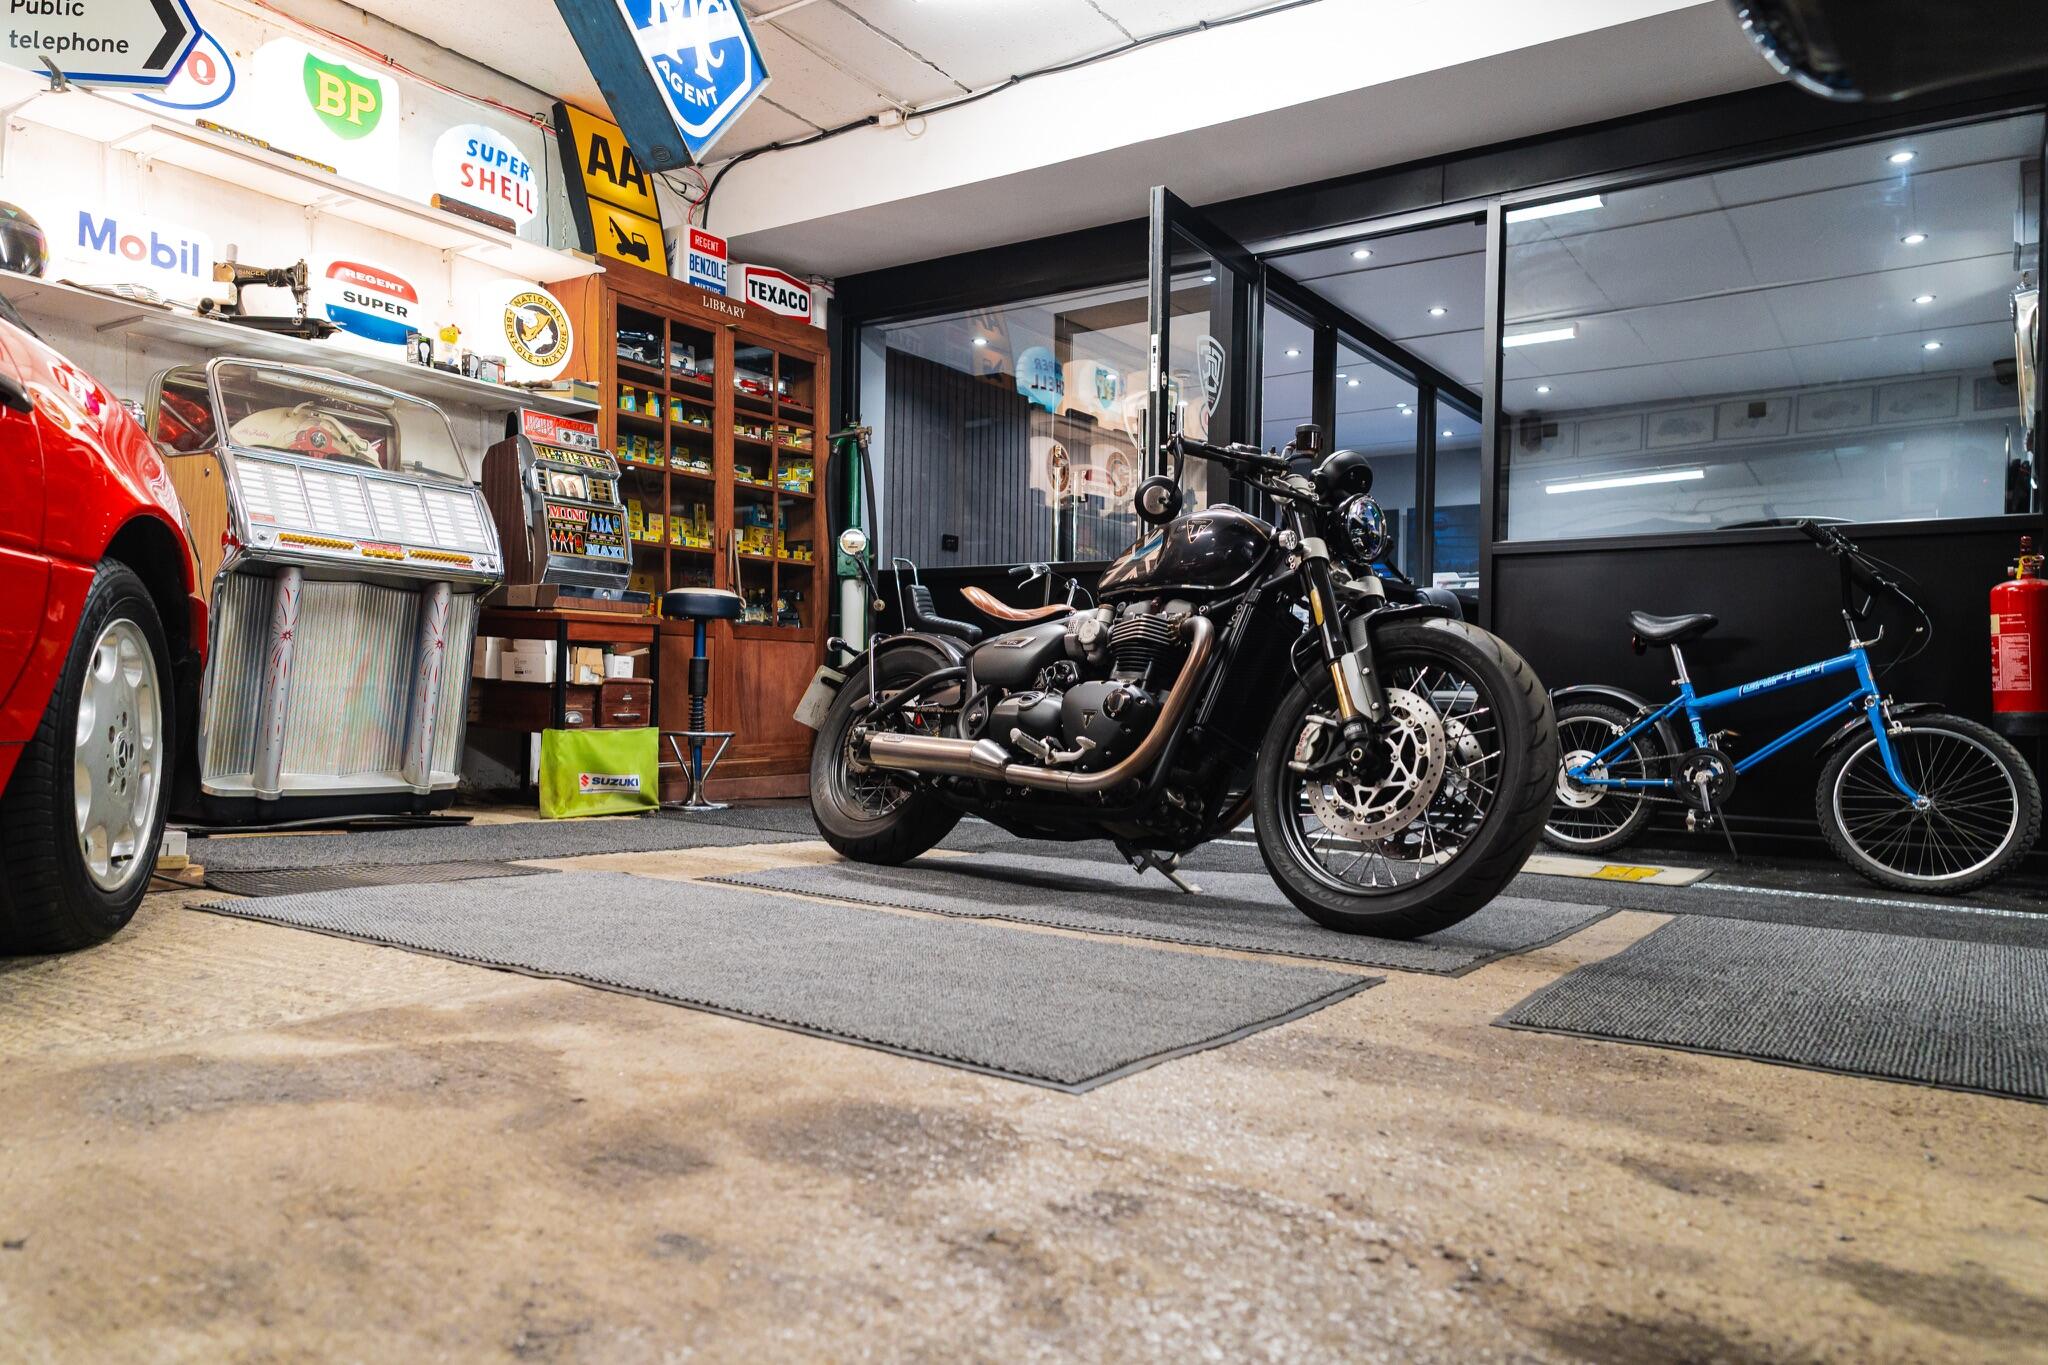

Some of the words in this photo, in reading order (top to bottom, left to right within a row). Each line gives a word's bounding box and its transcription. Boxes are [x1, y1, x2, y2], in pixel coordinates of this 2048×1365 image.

[10, 0, 84, 16] Public
[9, 29, 129, 54] telephone
[315, 68, 376, 126] BP
[656, 60, 718, 108] AGENT
[466, 138, 530, 182] SUPER
[587, 132, 647, 197] AA
[460, 161, 533, 215] SHELL
[78, 209, 200, 278] Mobil
[694, 234, 719, 252] REGENT
[343, 268, 405, 293] REGENT
[689, 253, 727, 282] BENZOLE
[343, 290, 408, 318] SUPER
[514, 294, 561, 322] NATIONAL
[702, 295, 746, 319] LIBRARY
[748, 278, 808, 312] TEXACO
[506, 316, 533, 361] BENZOLE
[542, 331, 567, 364] MIXTURE
[548, 504, 588, 523] MINI
[585, 543, 625, 559] MAXI
[591, 776, 639, 787] SUZUKI
